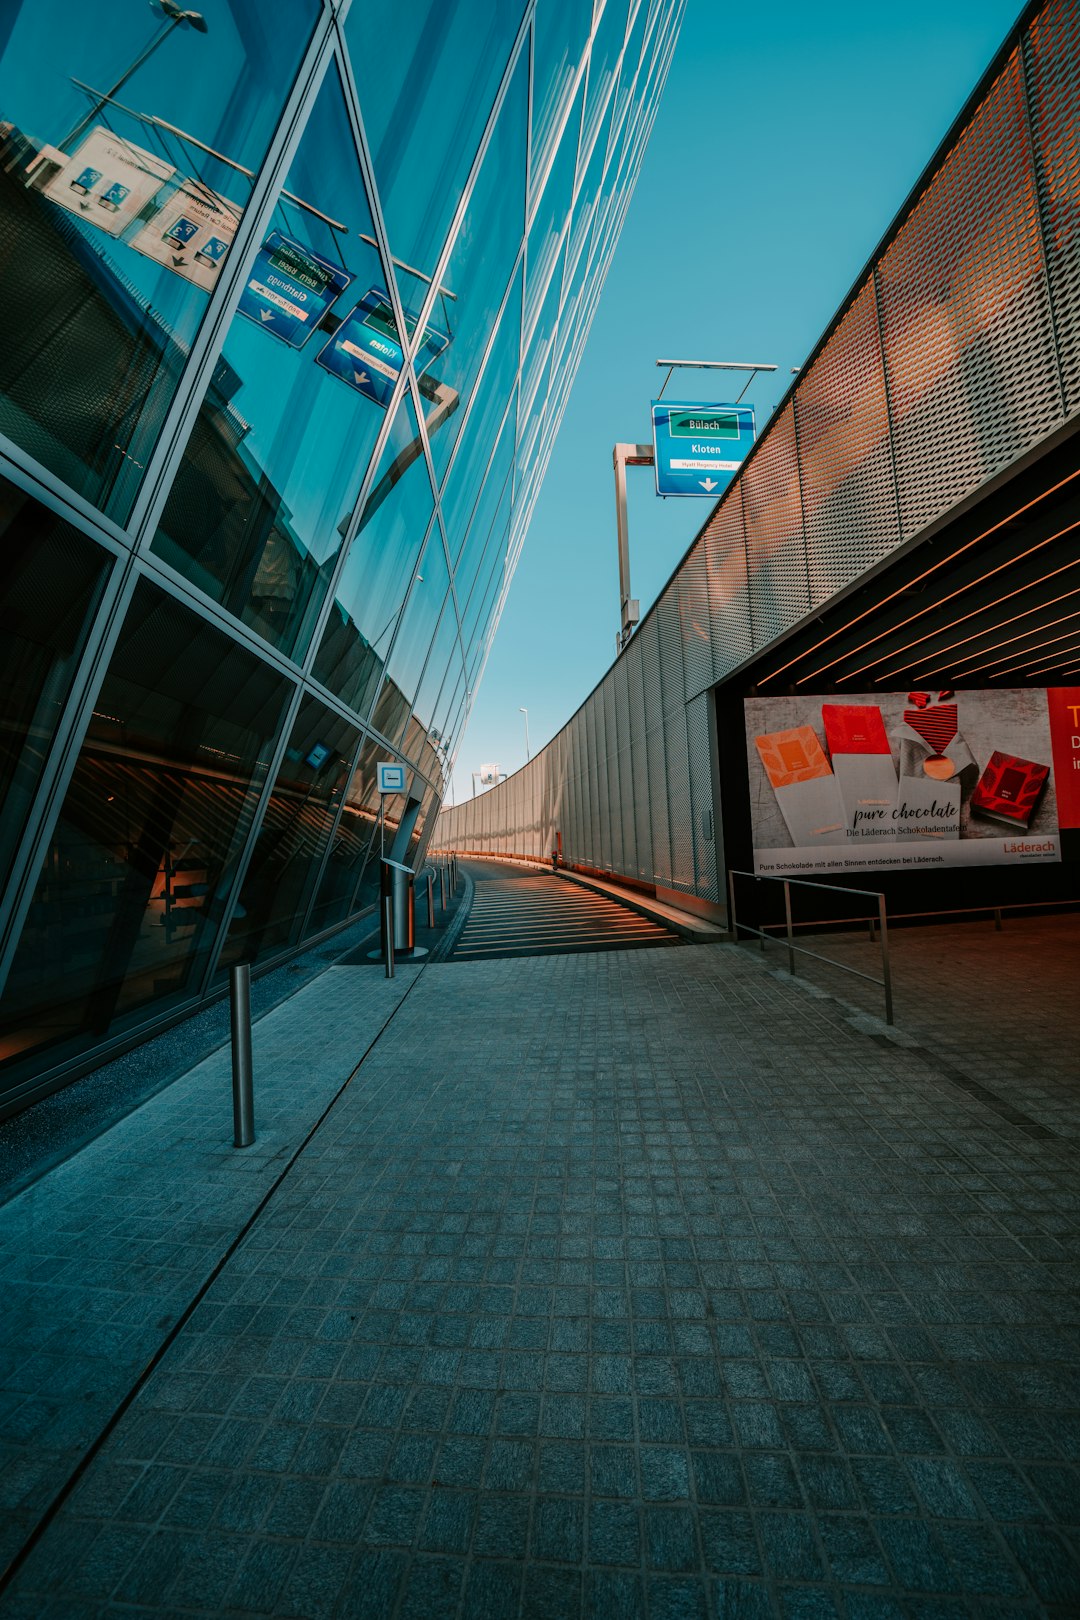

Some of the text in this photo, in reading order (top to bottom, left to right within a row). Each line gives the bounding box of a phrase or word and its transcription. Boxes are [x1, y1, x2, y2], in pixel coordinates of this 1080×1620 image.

[689, 419, 720, 430] Bülach
[691, 443, 721, 454] Kloten
[853, 800, 958, 829] pure chocolate
[846, 828, 860, 837] Die
[861, 825, 896, 836] Läderach
[897, 824, 968, 836] Schokoladentafeln
[1004, 841, 1056, 854] Läderach
[776, 861, 814, 870] Schokolade
[827, 859, 843, 867] allen
[844, 858, 867, 866] Sinnen
[868, 857, 901, 865] entdecken
[913, 855, 945, 863] Läderach.
